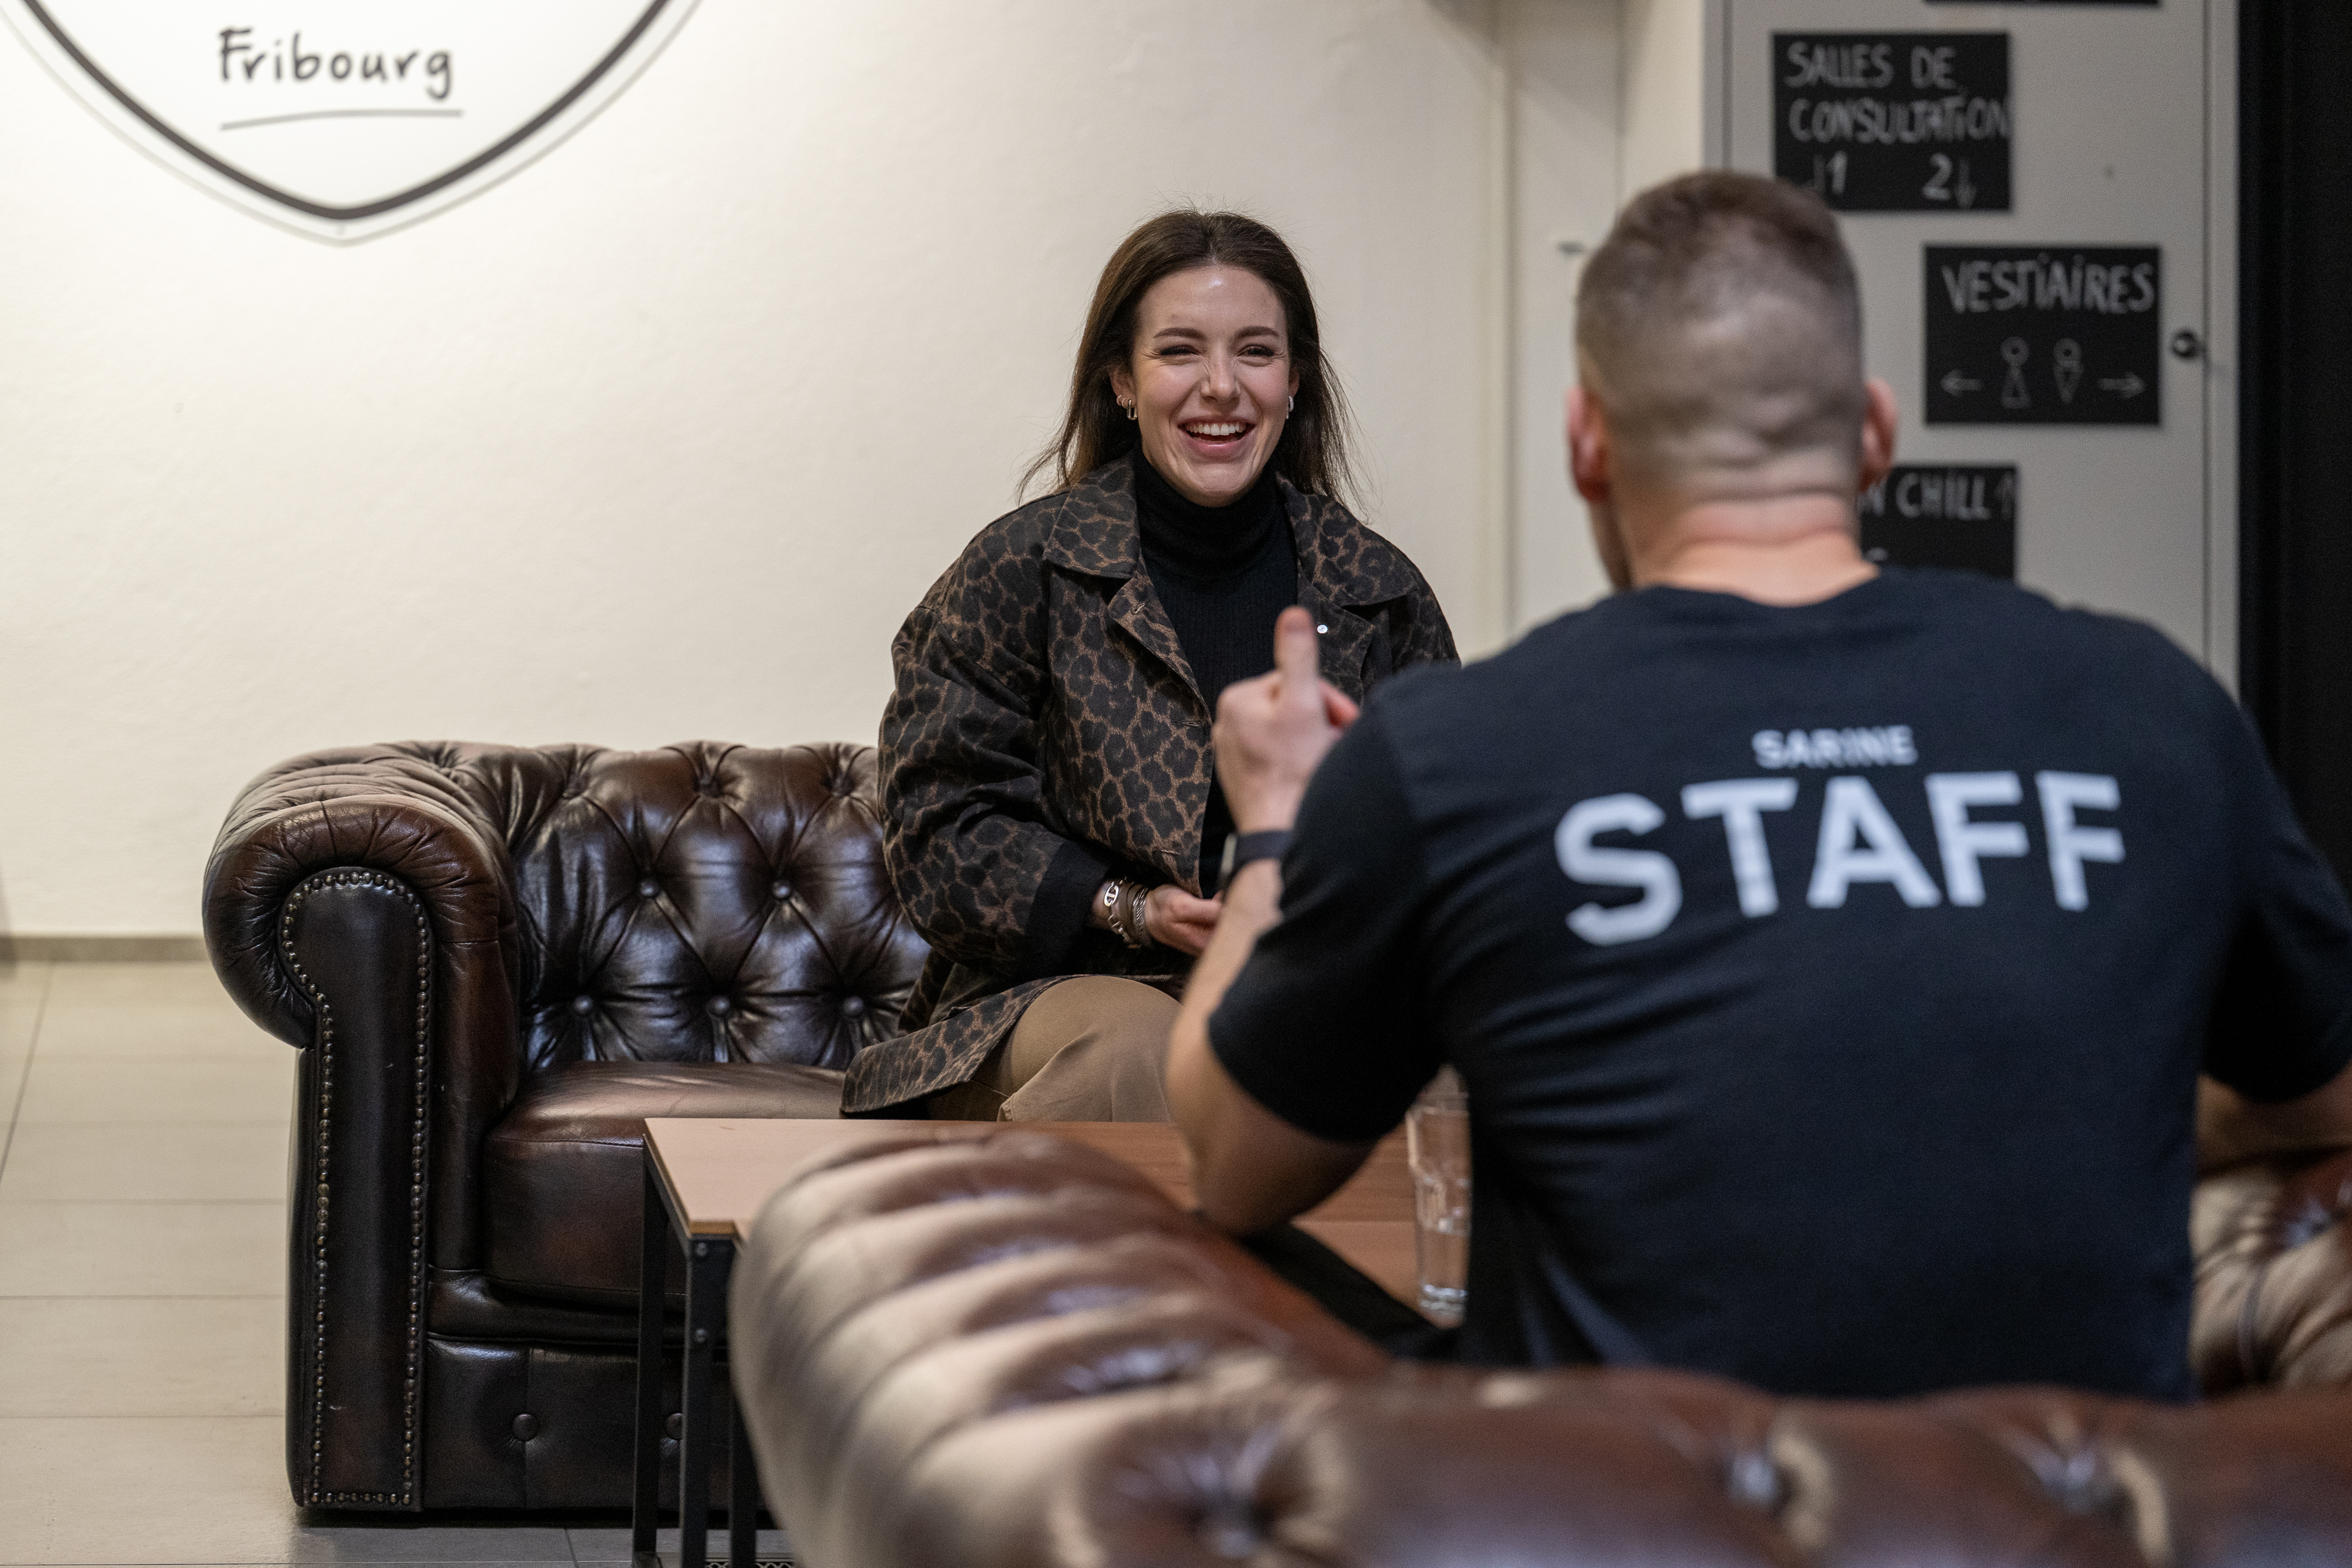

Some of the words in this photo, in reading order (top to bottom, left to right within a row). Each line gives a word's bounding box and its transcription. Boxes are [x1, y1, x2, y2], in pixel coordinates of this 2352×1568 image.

[218, 26, 453, 101] Fribourg
[1783, 41, 1895, 88] SALLES
[1910, 45, 1958, 89] DE
[1825, 150, 1848, 195] 1
[1921, 153, 1953, 200] 2
[1752, 726, 1918, 768] SARINE
[1554, 770, 2126, 945] STAFF
